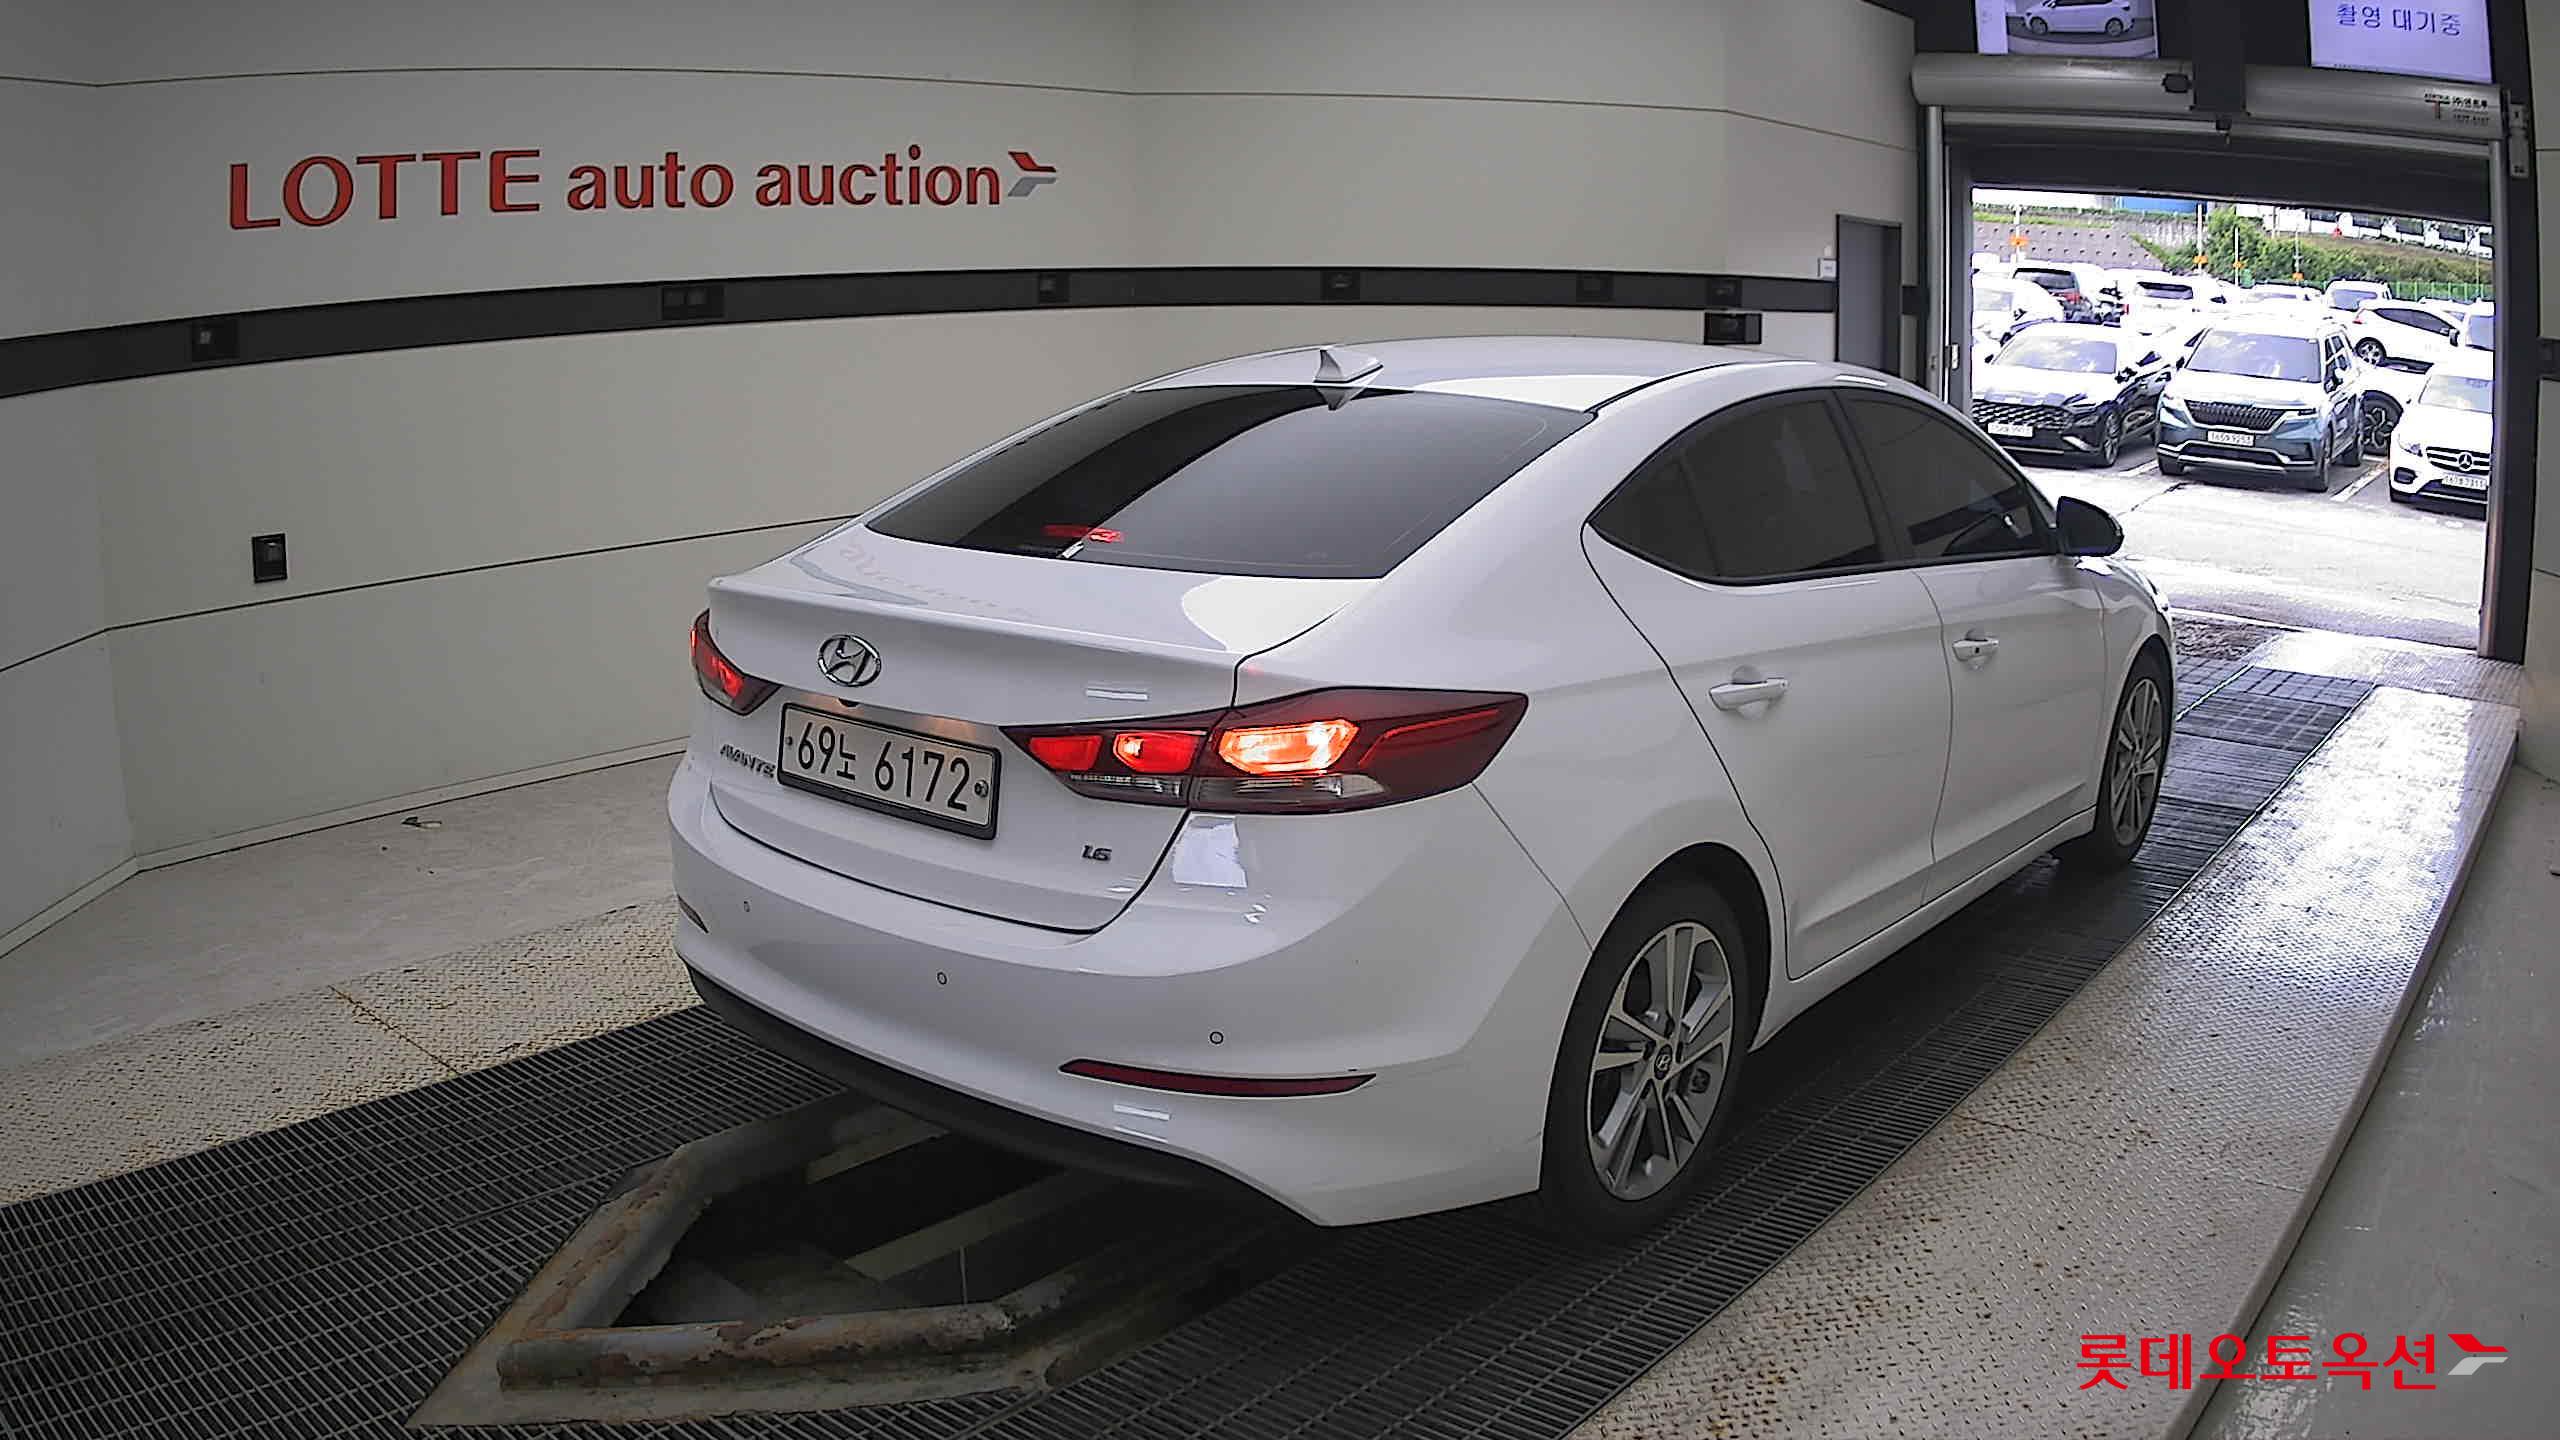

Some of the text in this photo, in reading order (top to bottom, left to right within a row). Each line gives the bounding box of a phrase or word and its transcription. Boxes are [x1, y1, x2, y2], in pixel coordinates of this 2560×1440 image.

[2337, 3, 2462, 36] 촬영 대기중
[229, 144, 1000, 230] LOTTE auto auction
[719, 743, 776, 778] AVANTE
[797, 720, 972, 813] 69노 6172
